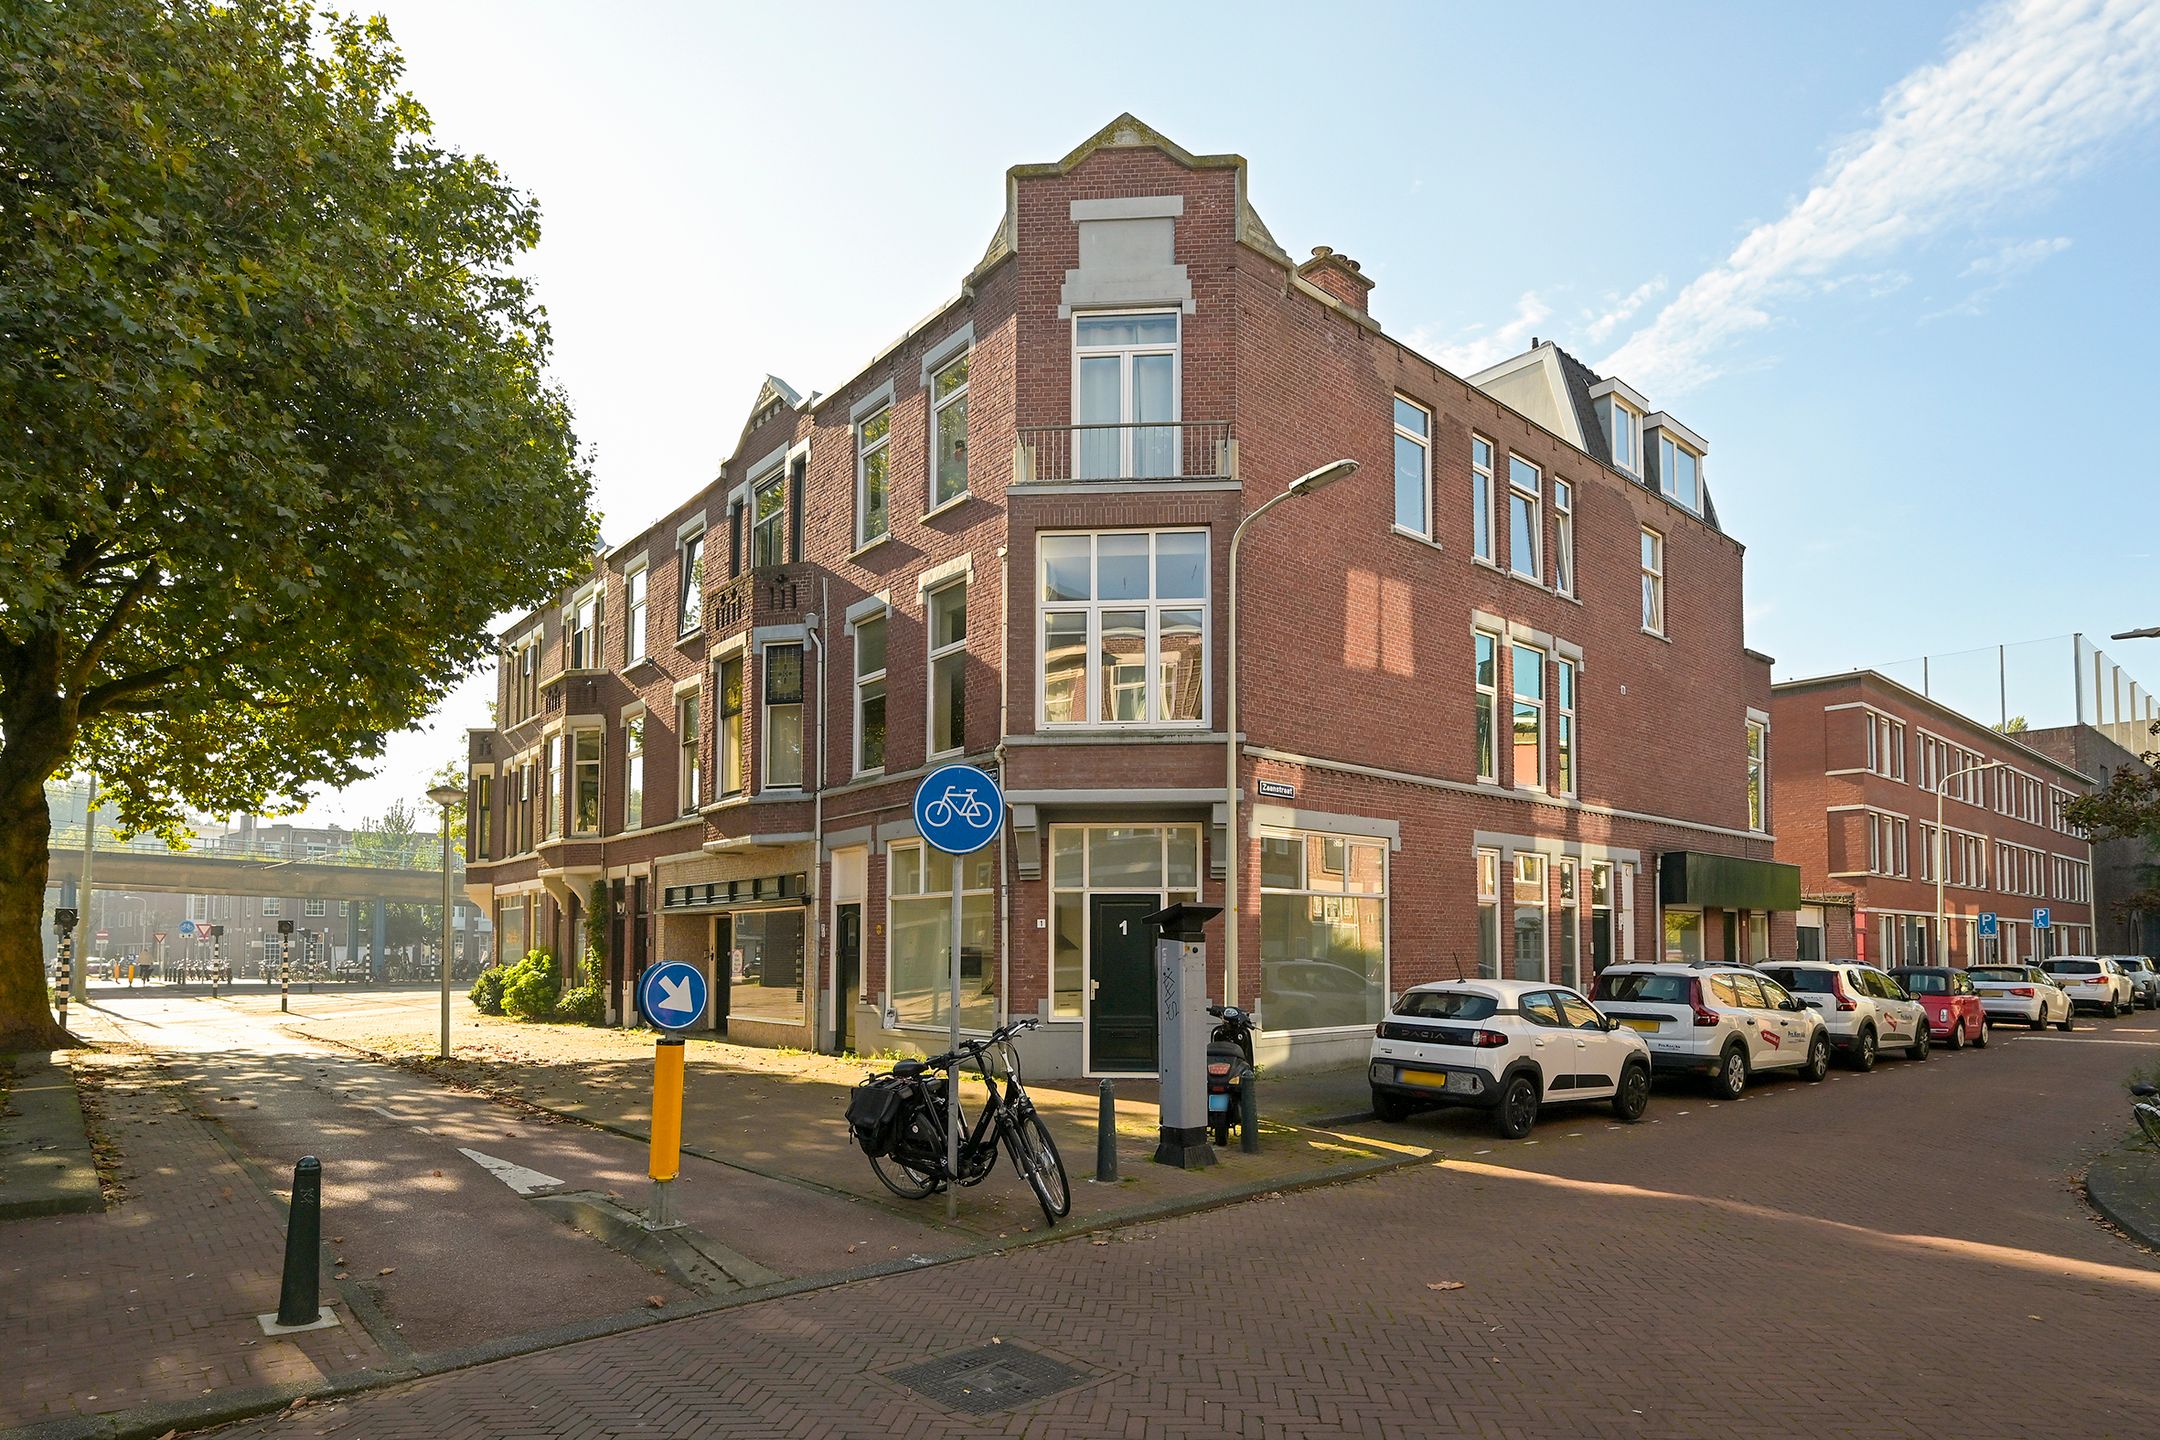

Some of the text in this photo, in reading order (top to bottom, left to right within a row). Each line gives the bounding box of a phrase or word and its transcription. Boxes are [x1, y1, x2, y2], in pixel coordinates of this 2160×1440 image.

[1262, 783, 1293, 795] Zaanstraat
[1982, 914, 1992, 925] P
[2037, 909, 2046, 919] P
[1119, 920, 1128, 936] 1
[1401, 1029, 1445, 1040] DACIA
